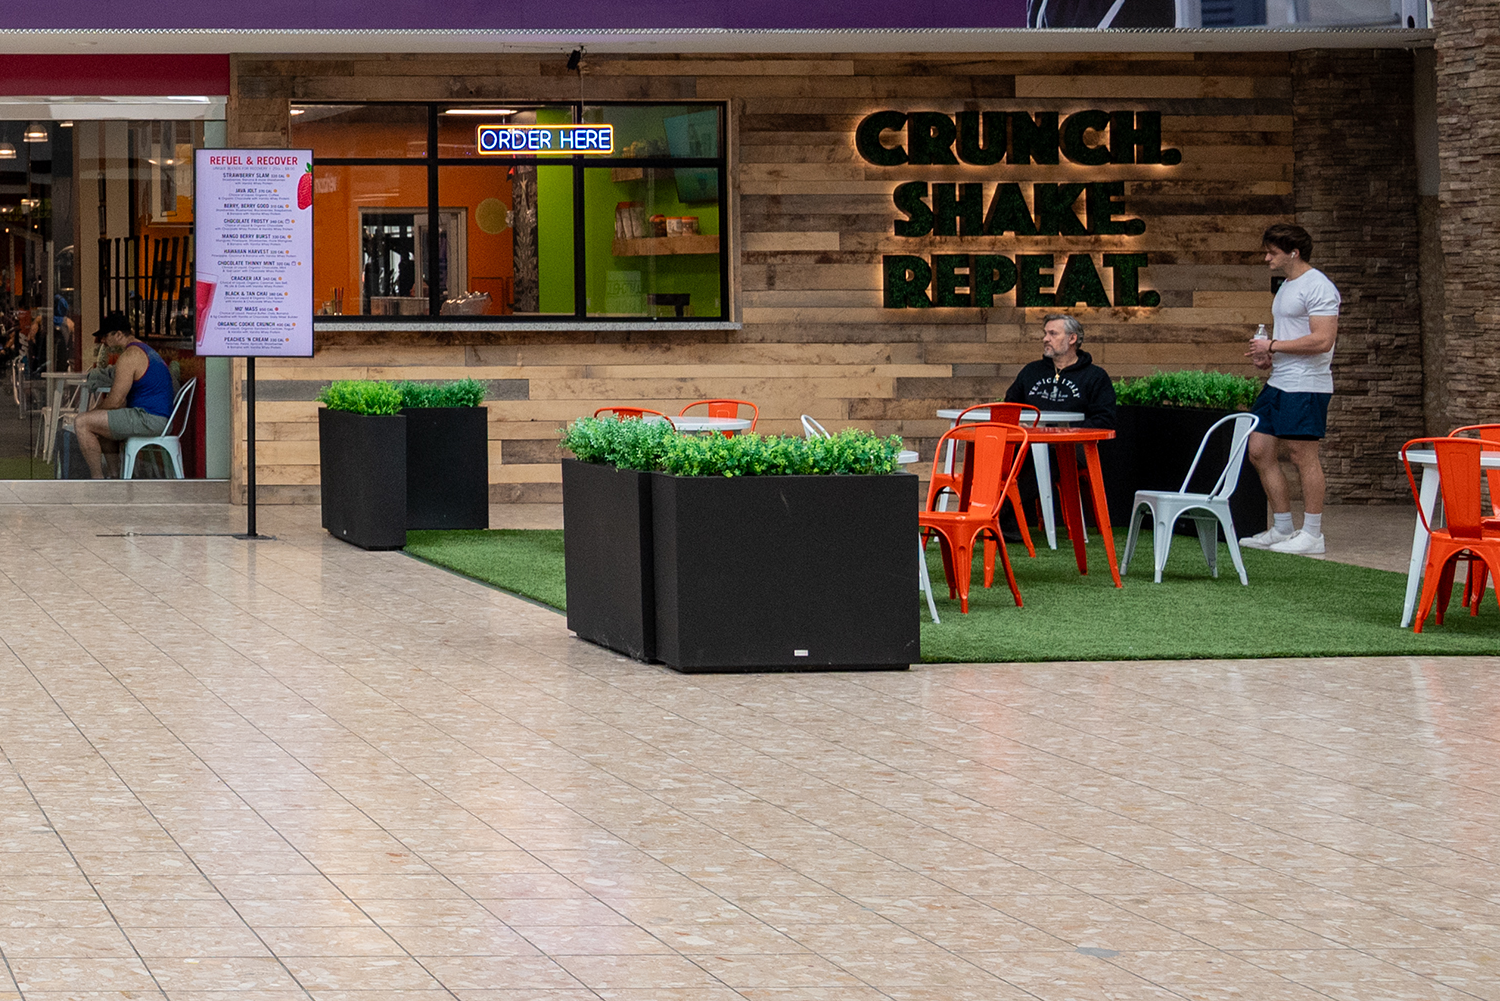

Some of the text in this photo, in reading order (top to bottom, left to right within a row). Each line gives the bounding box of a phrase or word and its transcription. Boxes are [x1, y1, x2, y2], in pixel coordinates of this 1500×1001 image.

[480, 128, 612, 150] ORDER HERE
[855, 109, 1183, 166] CRUNCH.
[210, 156, 298, 165] REFUEL & RECOVER
[892, 180, 1146, 238] SHAKE.
[882, 253, 1161, 309] REPEAT.
[1061, 378, 1080, 398] ITALY
